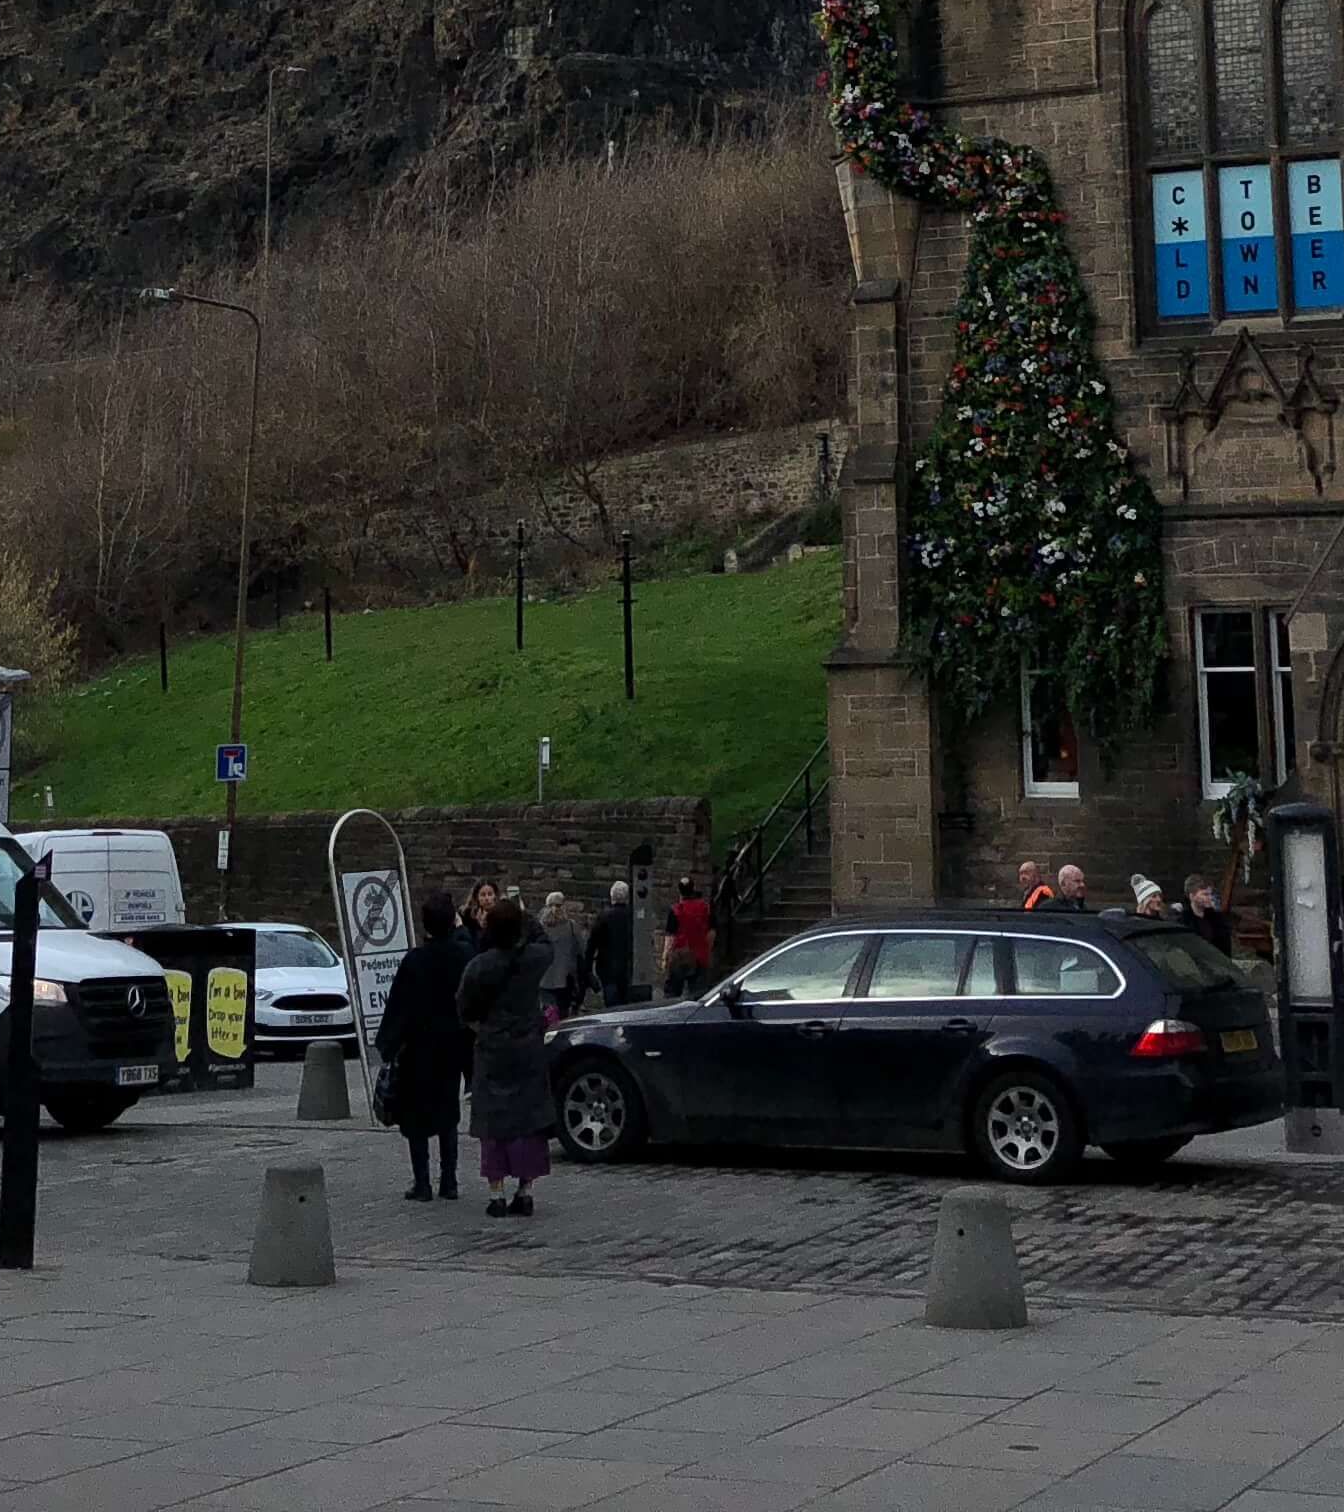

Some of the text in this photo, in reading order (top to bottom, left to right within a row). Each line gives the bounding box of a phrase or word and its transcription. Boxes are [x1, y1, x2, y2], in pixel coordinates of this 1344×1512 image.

[1239, 180, 1259, 295] TOWN
[1307, 174, 1327, 290] BEER
[233, 984, 246, 999] bin
